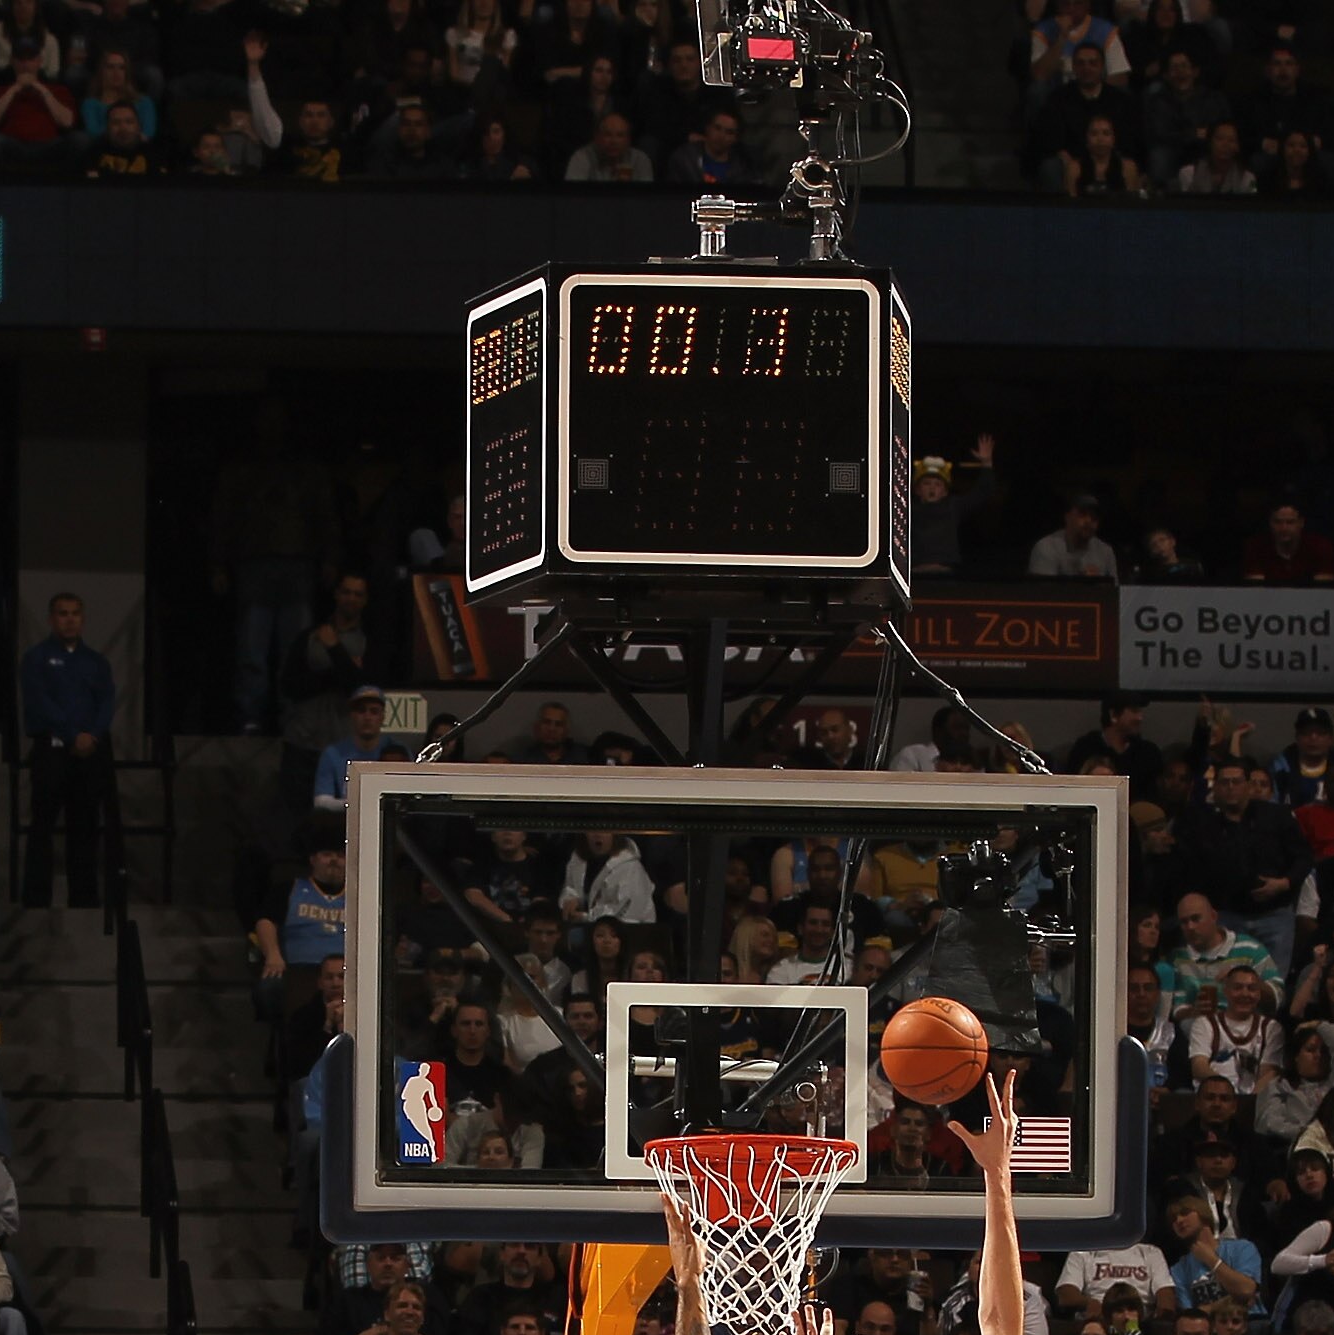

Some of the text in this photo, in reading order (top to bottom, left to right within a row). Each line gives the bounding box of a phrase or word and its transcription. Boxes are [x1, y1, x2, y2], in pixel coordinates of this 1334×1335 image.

[975, 612, 1082, 650] ZONE
[1134, 606, 1331, 645] Go Beyond
[1134, 641, 1330, 674] The Usual.
[380, 696, 424, 730] XIT
[297, 904, 345, 924] DENV
[405, 1143, 430, 1159] NBA
